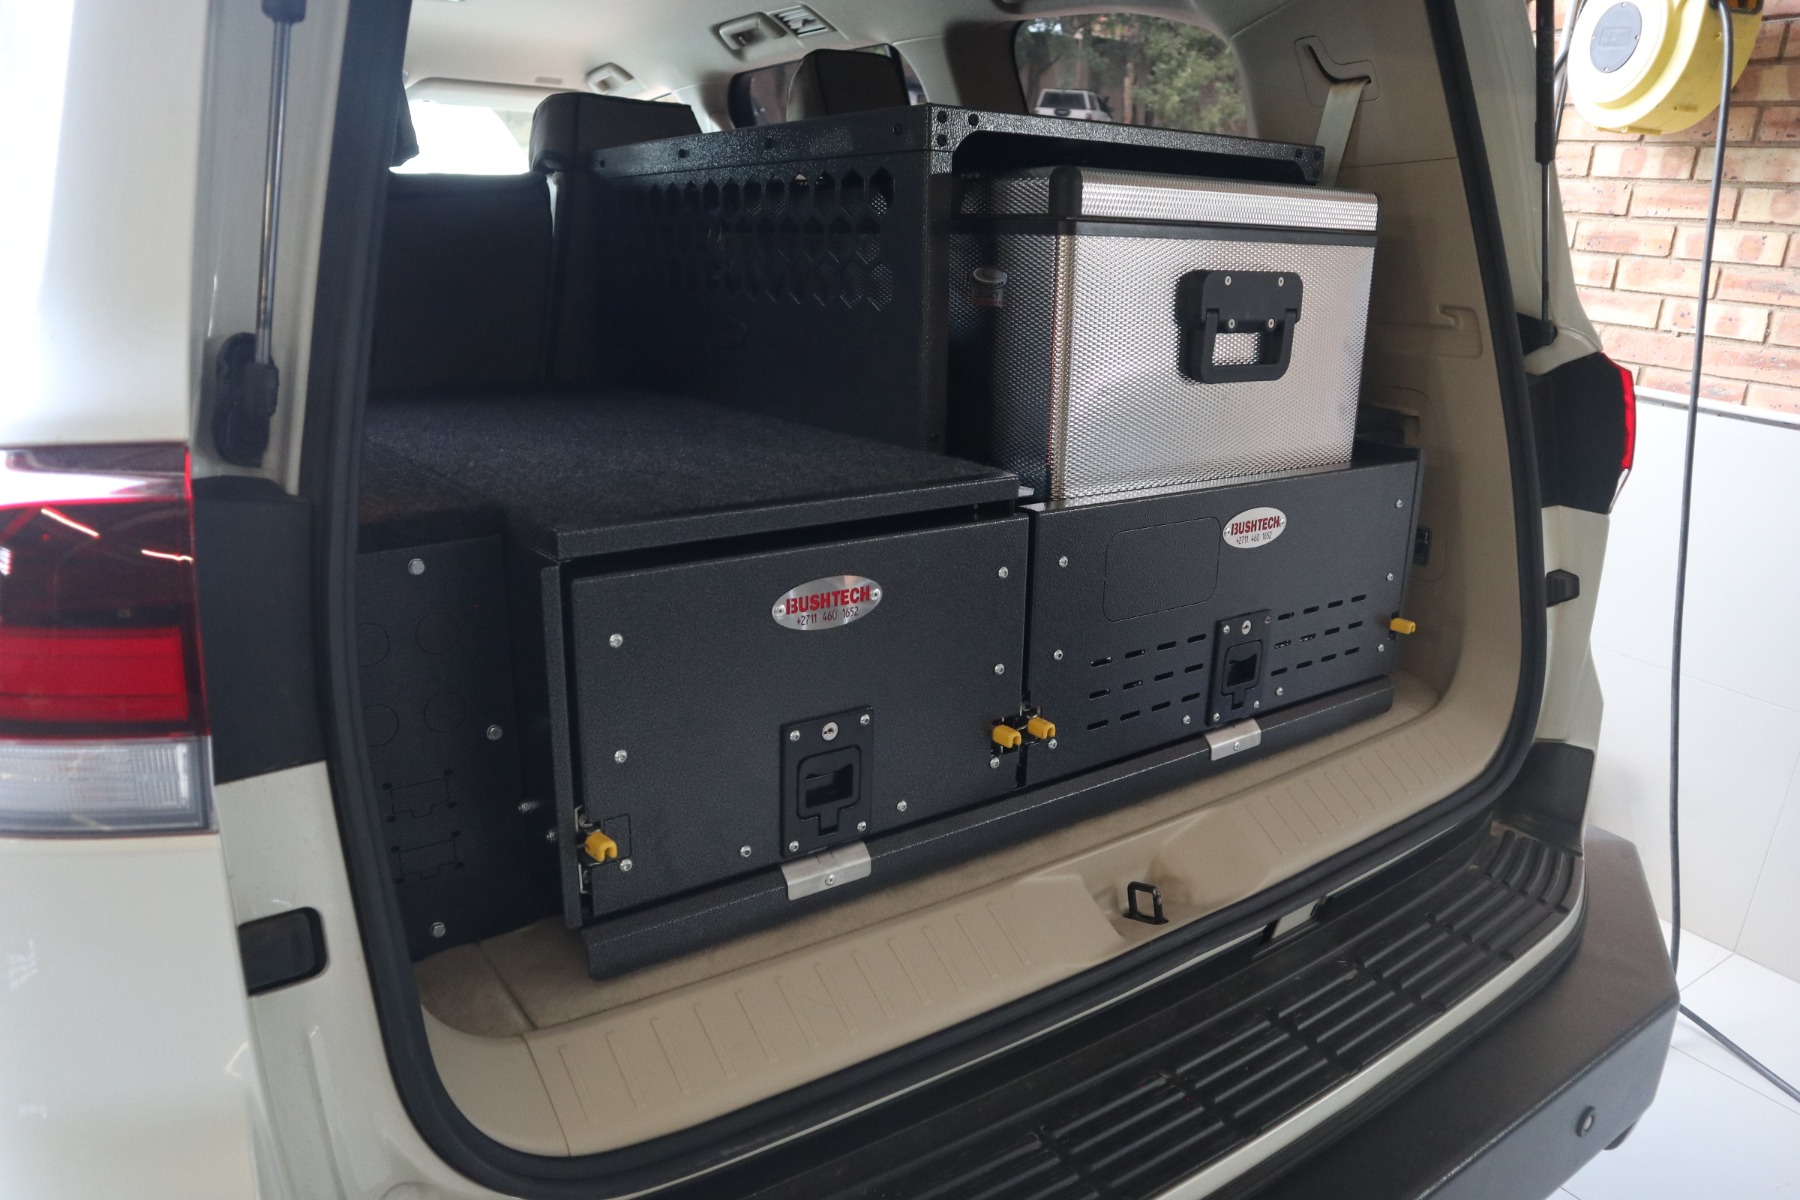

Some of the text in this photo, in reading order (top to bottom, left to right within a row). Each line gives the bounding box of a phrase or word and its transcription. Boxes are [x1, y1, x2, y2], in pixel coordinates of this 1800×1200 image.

[1231, 516, 1280, 536] BUSHTECH
[1236, 535, 1249, 545] +2711
[786, 585, 870, 615] BUSHTECH
[797, 606, 859, 626] +2711 460 1652
